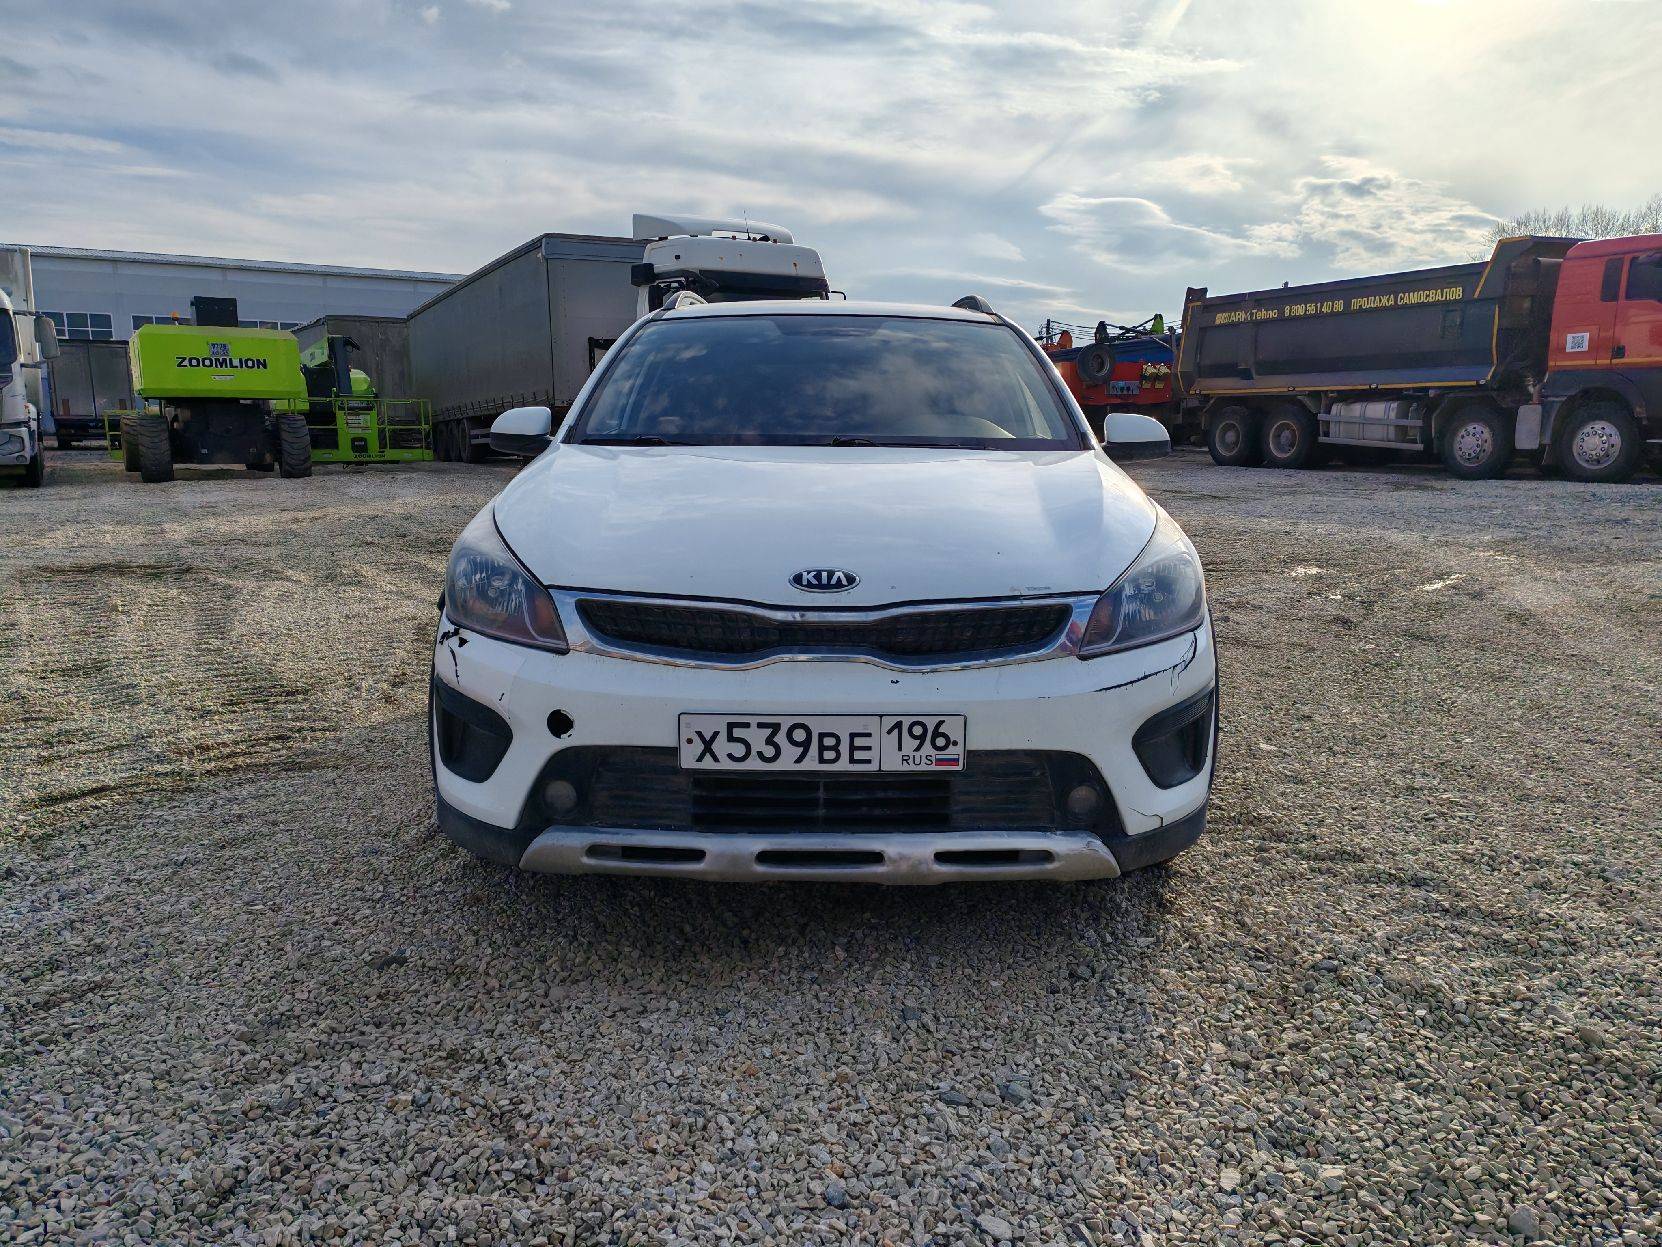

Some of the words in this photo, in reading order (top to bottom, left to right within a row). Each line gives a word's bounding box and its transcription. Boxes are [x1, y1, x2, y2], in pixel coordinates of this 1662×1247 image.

[1350, 294, 1395, 310] ПРОДАЖА
[1397, 286, 1463, 305] САМОСВАЛОВ
[175, 356, 268, 370] ZOOMLION
[802, 571, 849, 586] KIA
[885, 719, 951, 753] 196
[901, 754, 934, 767] RUS
